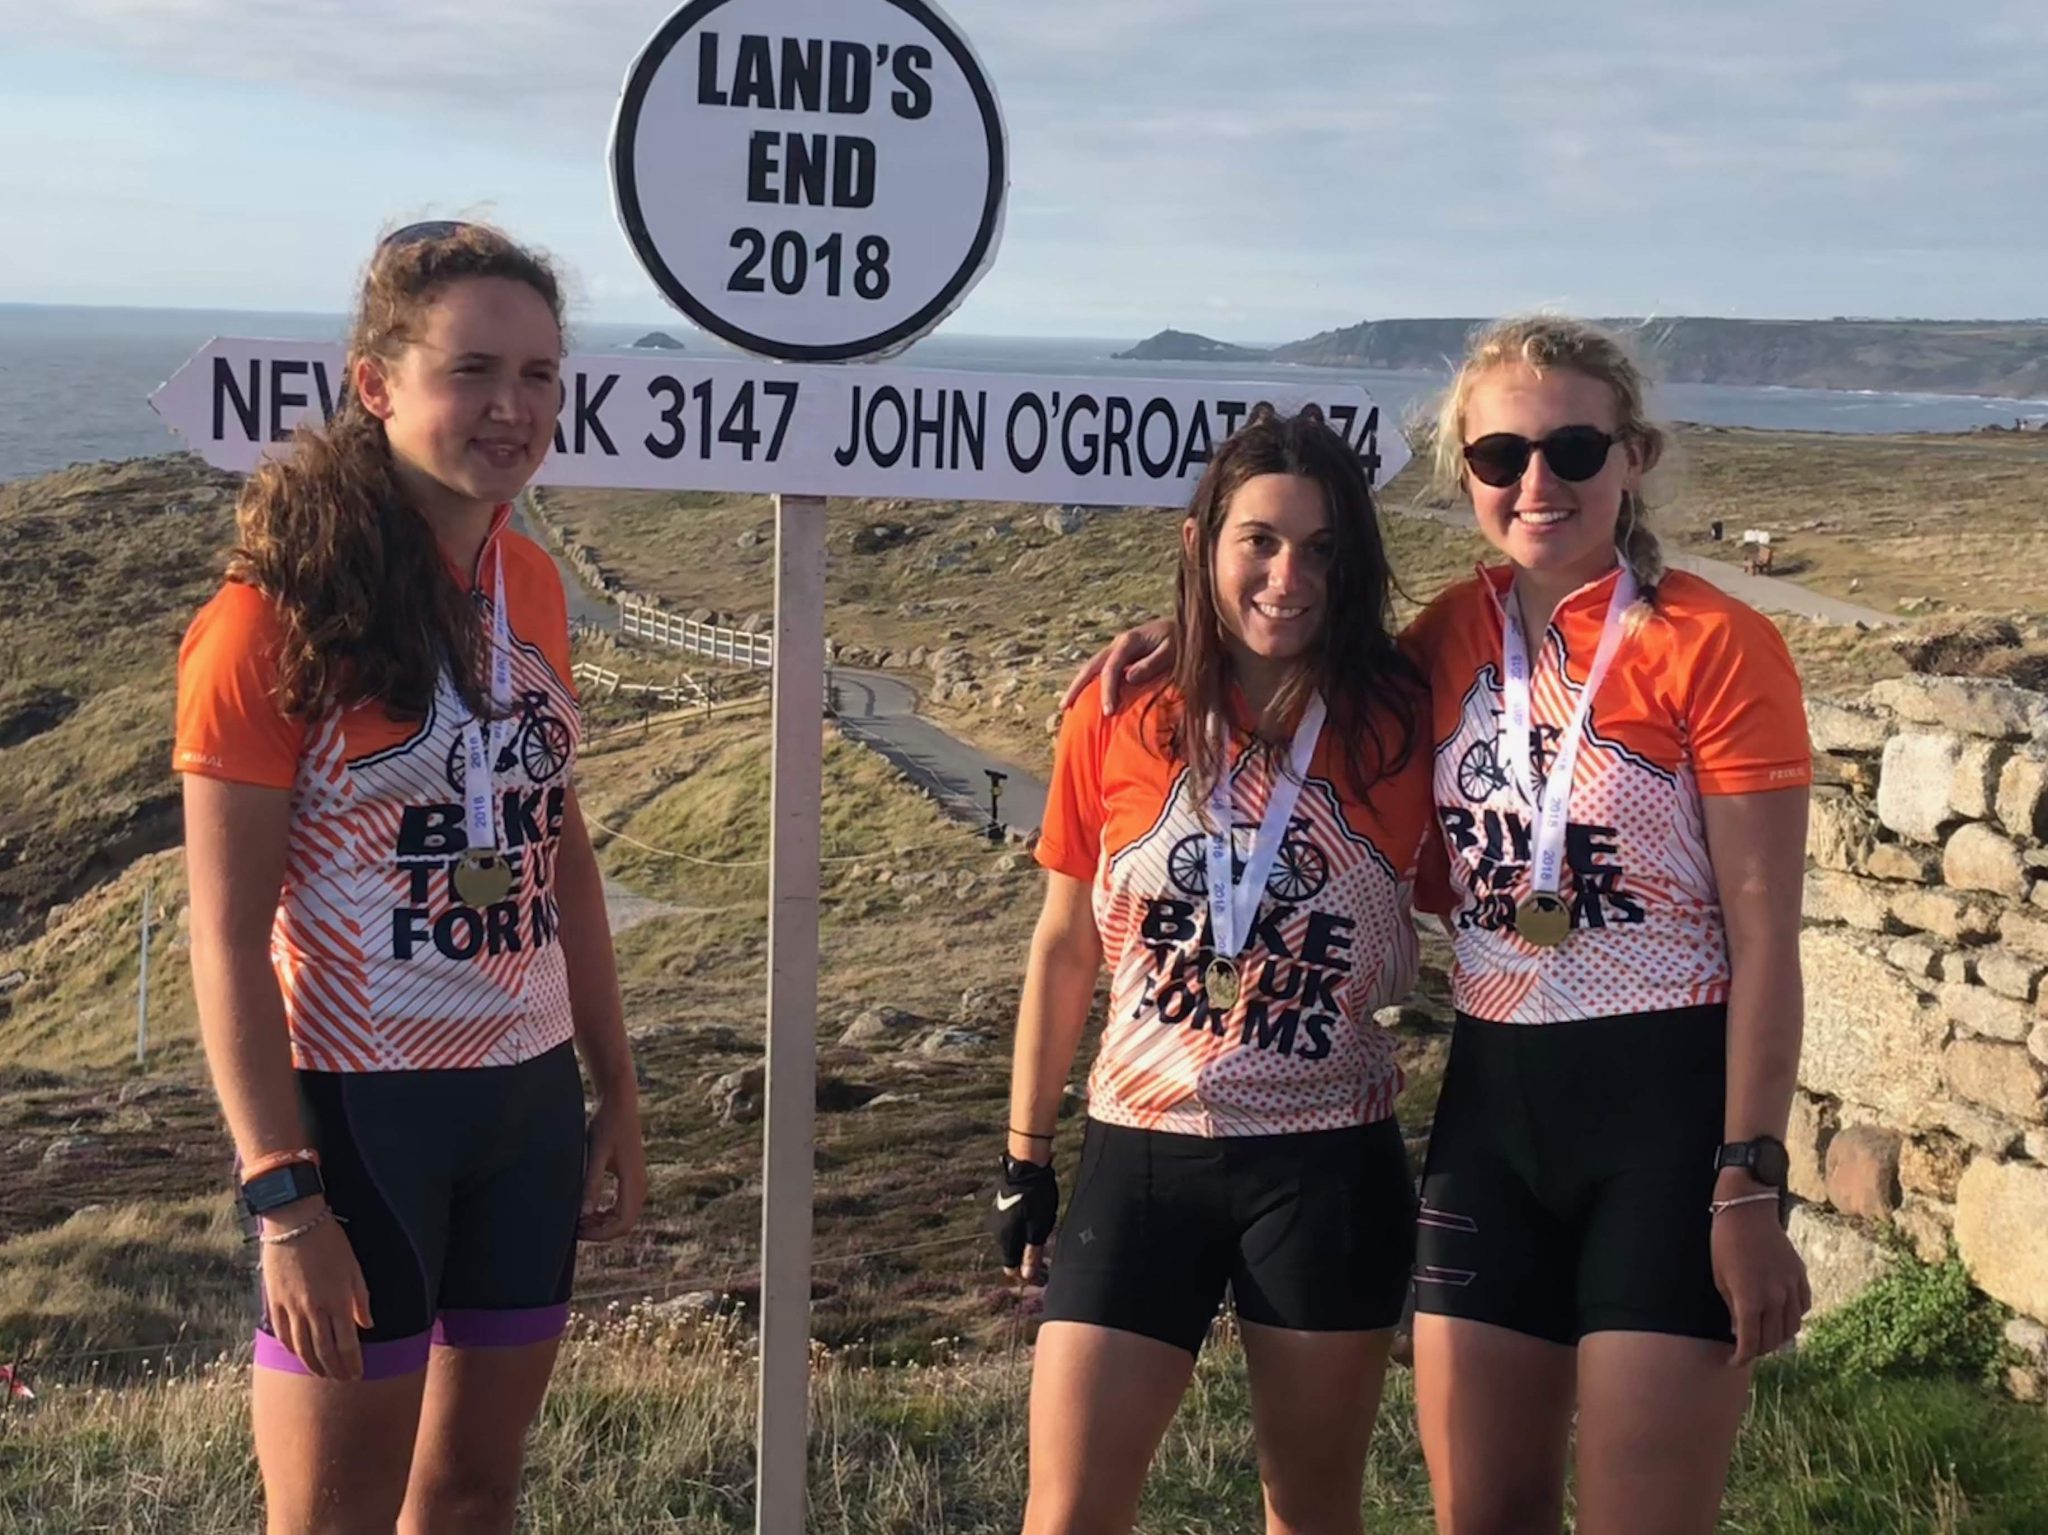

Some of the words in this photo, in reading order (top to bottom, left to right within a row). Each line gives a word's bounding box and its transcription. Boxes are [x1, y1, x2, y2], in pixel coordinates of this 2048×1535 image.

[698, 31, 933, 120] LAND'S
[747, 130, 877, 209] END
[726, 227, 891, 300] 2018
[643, 376, 799, 462] 3147
[834, 385, 987, 471] JOHN
[1006, 391, 1275, 479] O'GROAT
[473, 795, 488, 829] 2018
[393, 900, 522, 960] FOR
[1258, 958, 1344, 1015] UK
[1240, 1000, 1336, 1061] MS
